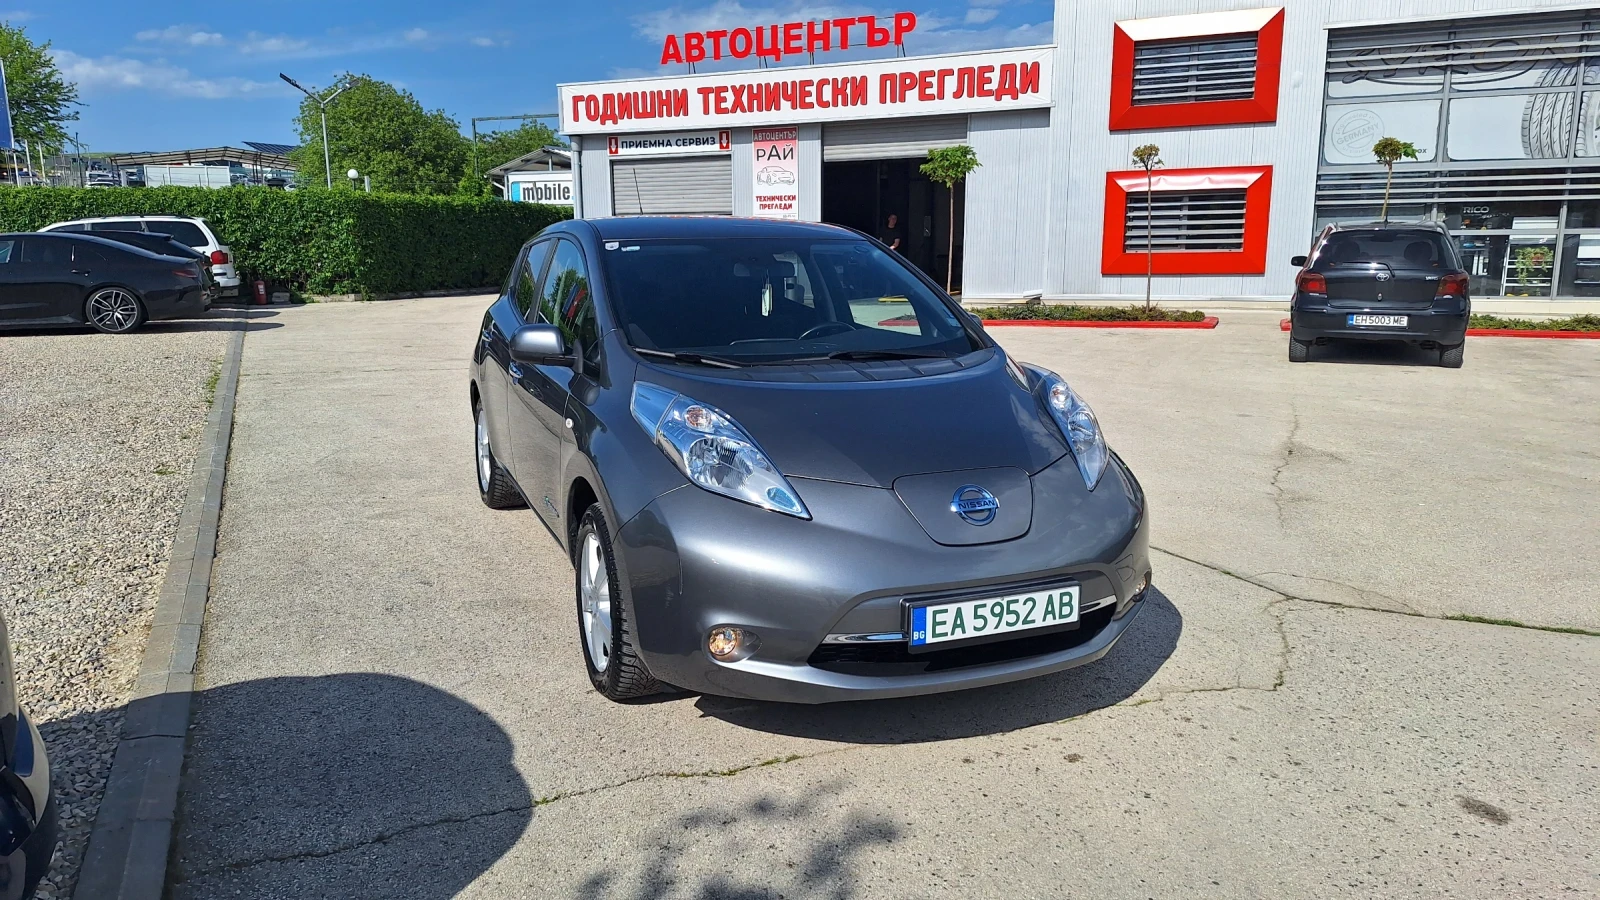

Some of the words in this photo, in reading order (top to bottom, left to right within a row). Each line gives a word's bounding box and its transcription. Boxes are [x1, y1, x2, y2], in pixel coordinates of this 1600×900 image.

[660, 11, 917, 65] АВТОЦЕНТЪР
[572, 88, 689, 125] ГОДИШНИ
[697, 75, 868, 116] ТЕХНИЧЕСКИ
[879, 61, 1041, 104] ПРЕГЛЕДИ
[753, 131, 797, 141] АВТОЦЕНТЪР
[1336, 122, 1379, 145] GERMANY
[621, 139, 673, 149] ПРИЕМНА
[675, 136, 716, 147] СЕРВИЗ
[755, 195, 797, 203] ТЕХНИЧЕСКИ
[759, 202, 793, 211] ПРЕГЛЕДИ
[1354, 315, 1368, 324] EH
[1368, 316, 1391, 325] 5003
[1392, 316, 1406, 325] ME
[957, 499, 996, 510] NISSAN
[913, 631, 925, 640] BG
[931, 607, 966, 639] EA
[973, 597, 1037, 632] 5952
[1042, 591, 1074, 622] AB
